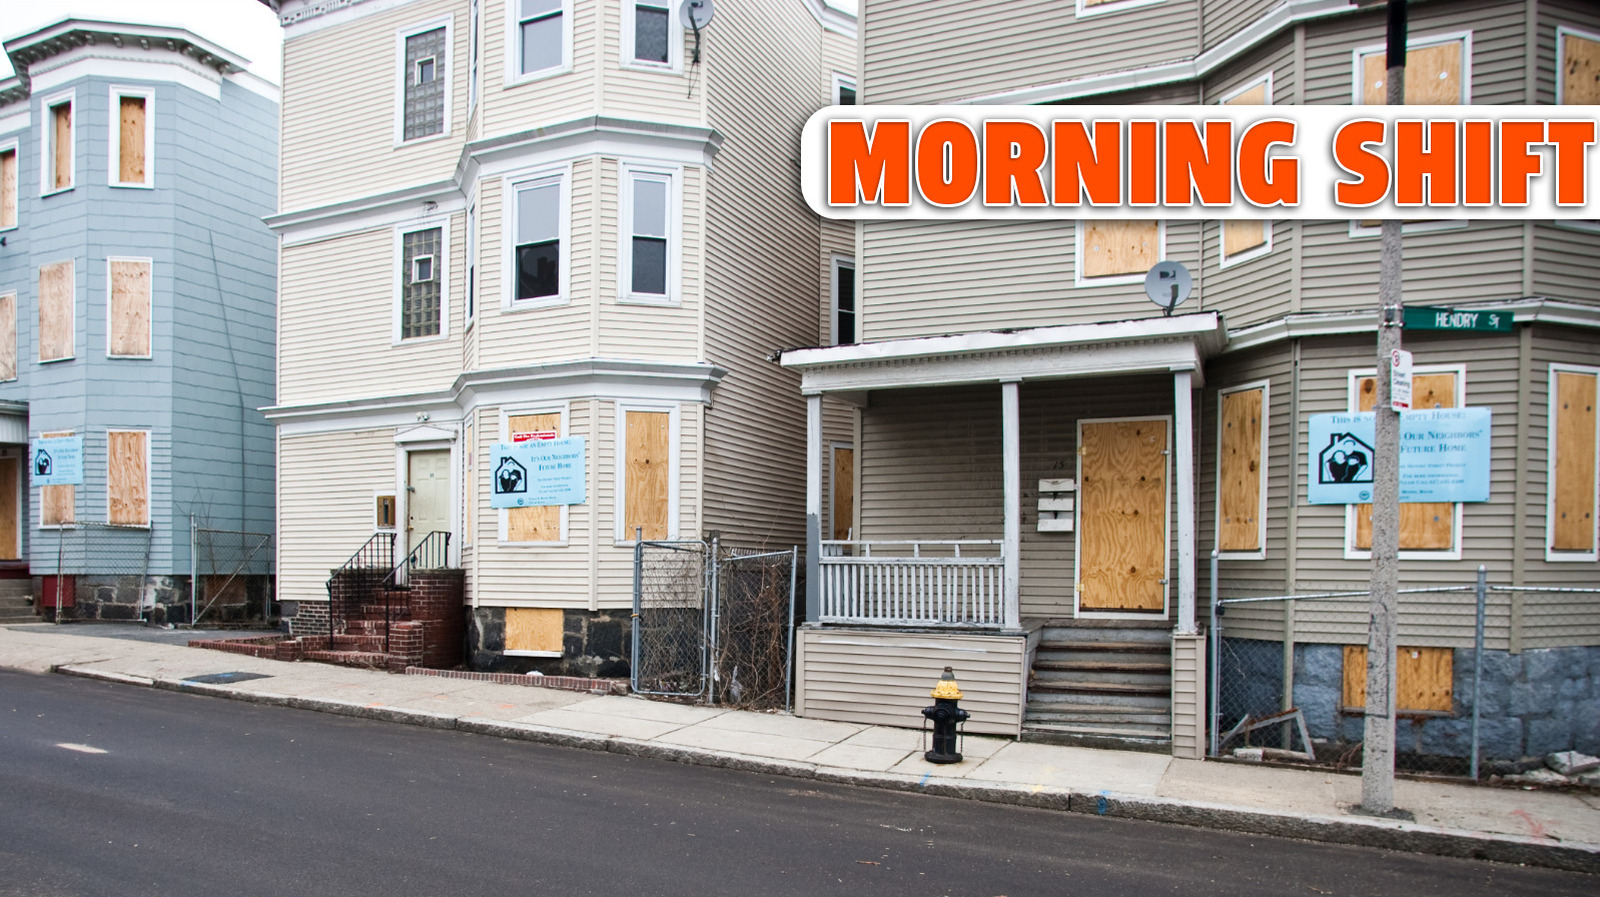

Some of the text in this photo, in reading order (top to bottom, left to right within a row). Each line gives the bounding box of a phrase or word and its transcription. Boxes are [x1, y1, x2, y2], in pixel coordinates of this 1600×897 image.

[1435, 312, 1479, 328] HENDRY
[1404, 431, 1424, 441] OUR
[1400, 443, 1467, 453] FUTURE HOME
[1053, 460, 1065, 470] 15
